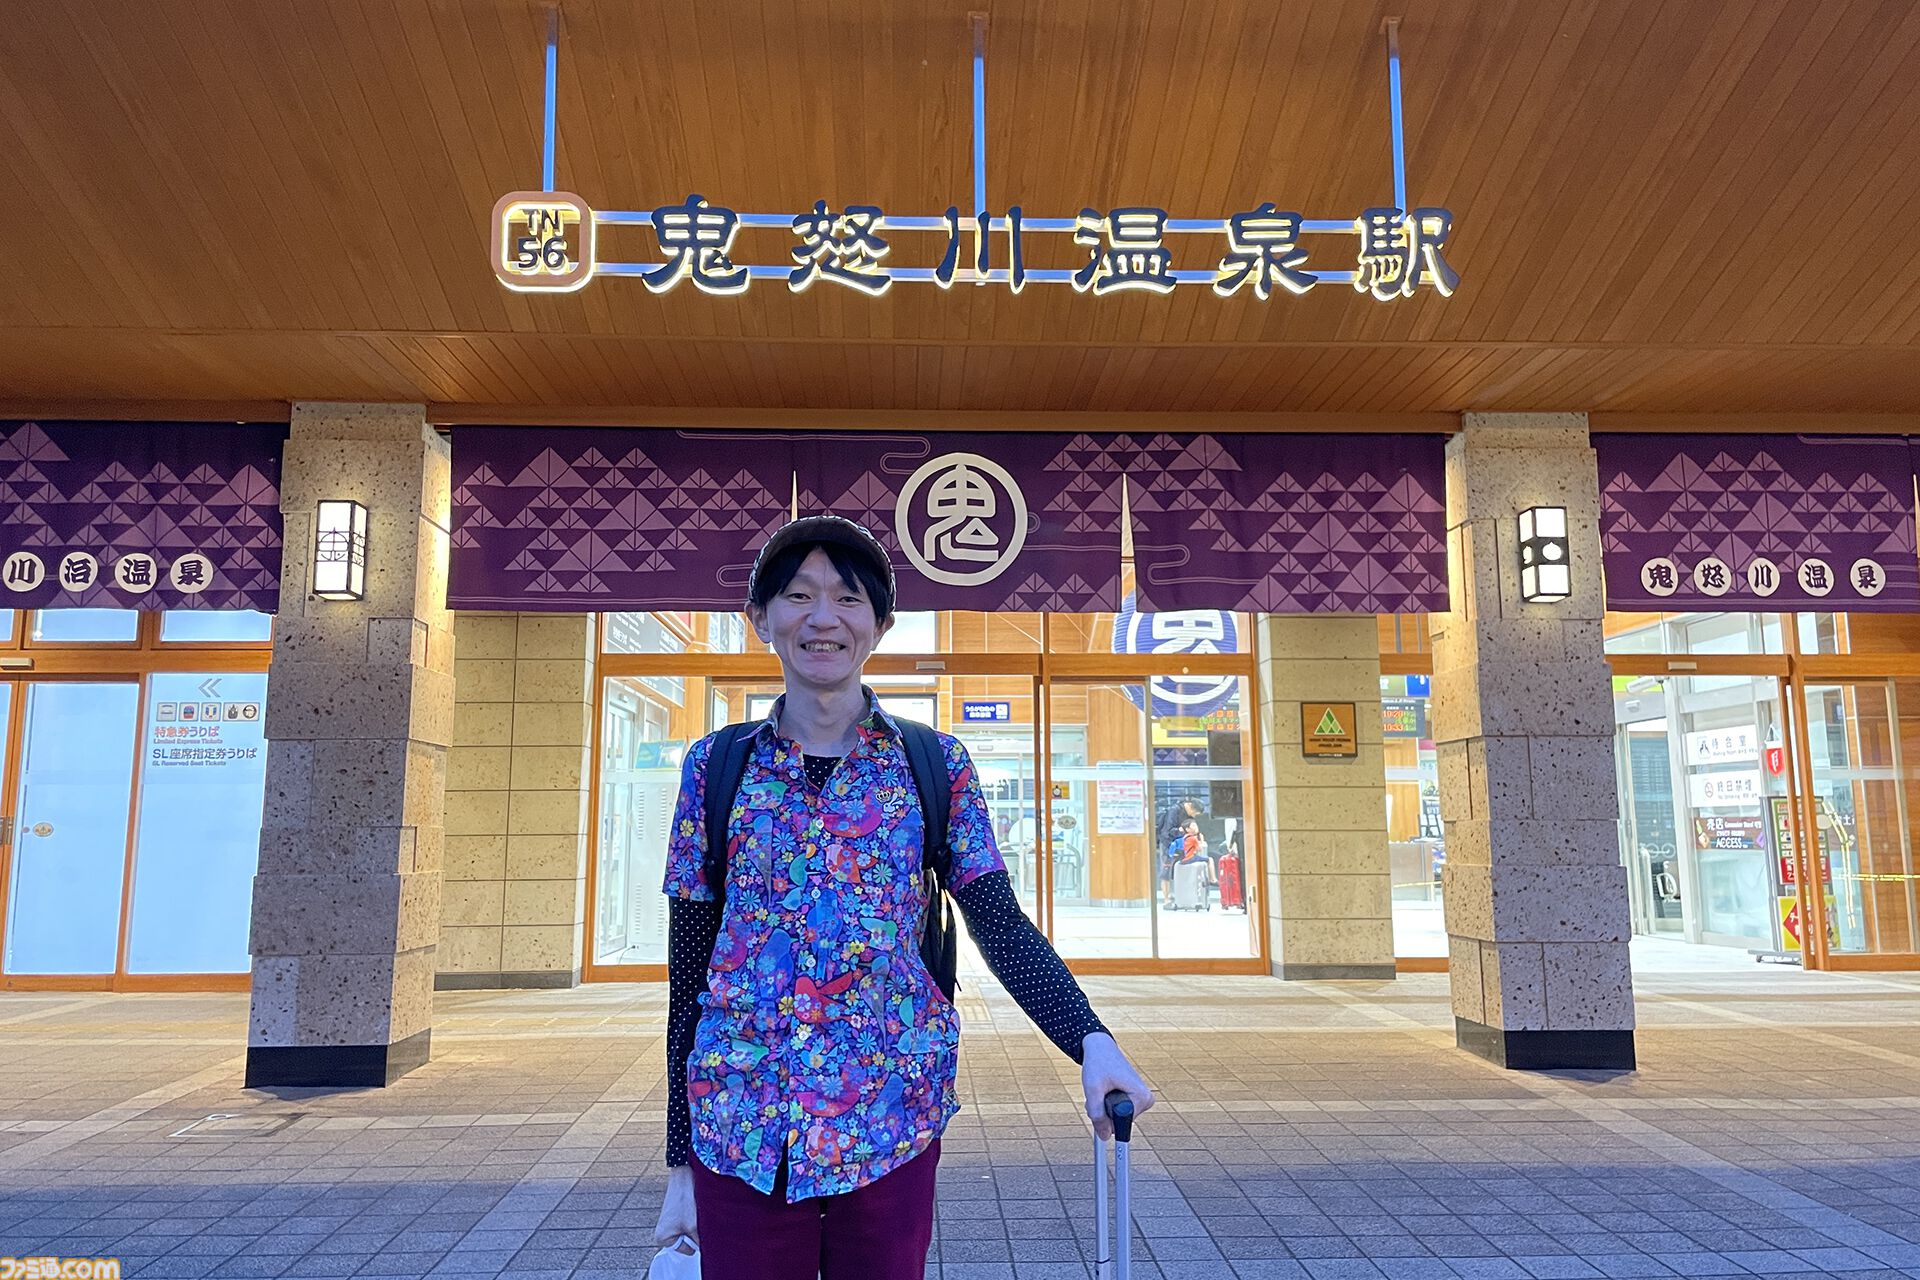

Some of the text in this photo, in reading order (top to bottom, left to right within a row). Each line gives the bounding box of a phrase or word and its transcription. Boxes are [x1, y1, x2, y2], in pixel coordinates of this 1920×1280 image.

[522, 208, 560, 229] TN
[518, 238, 566, 269] 56
[643, 193, 1460, 300] 鬼怒川温泉駅
[923, 463, 1000, 563] 鬼
[1647, 563, 1880, 591] 鬼怒川温泉
[154, 725, 220, 738] 特急券うりば
